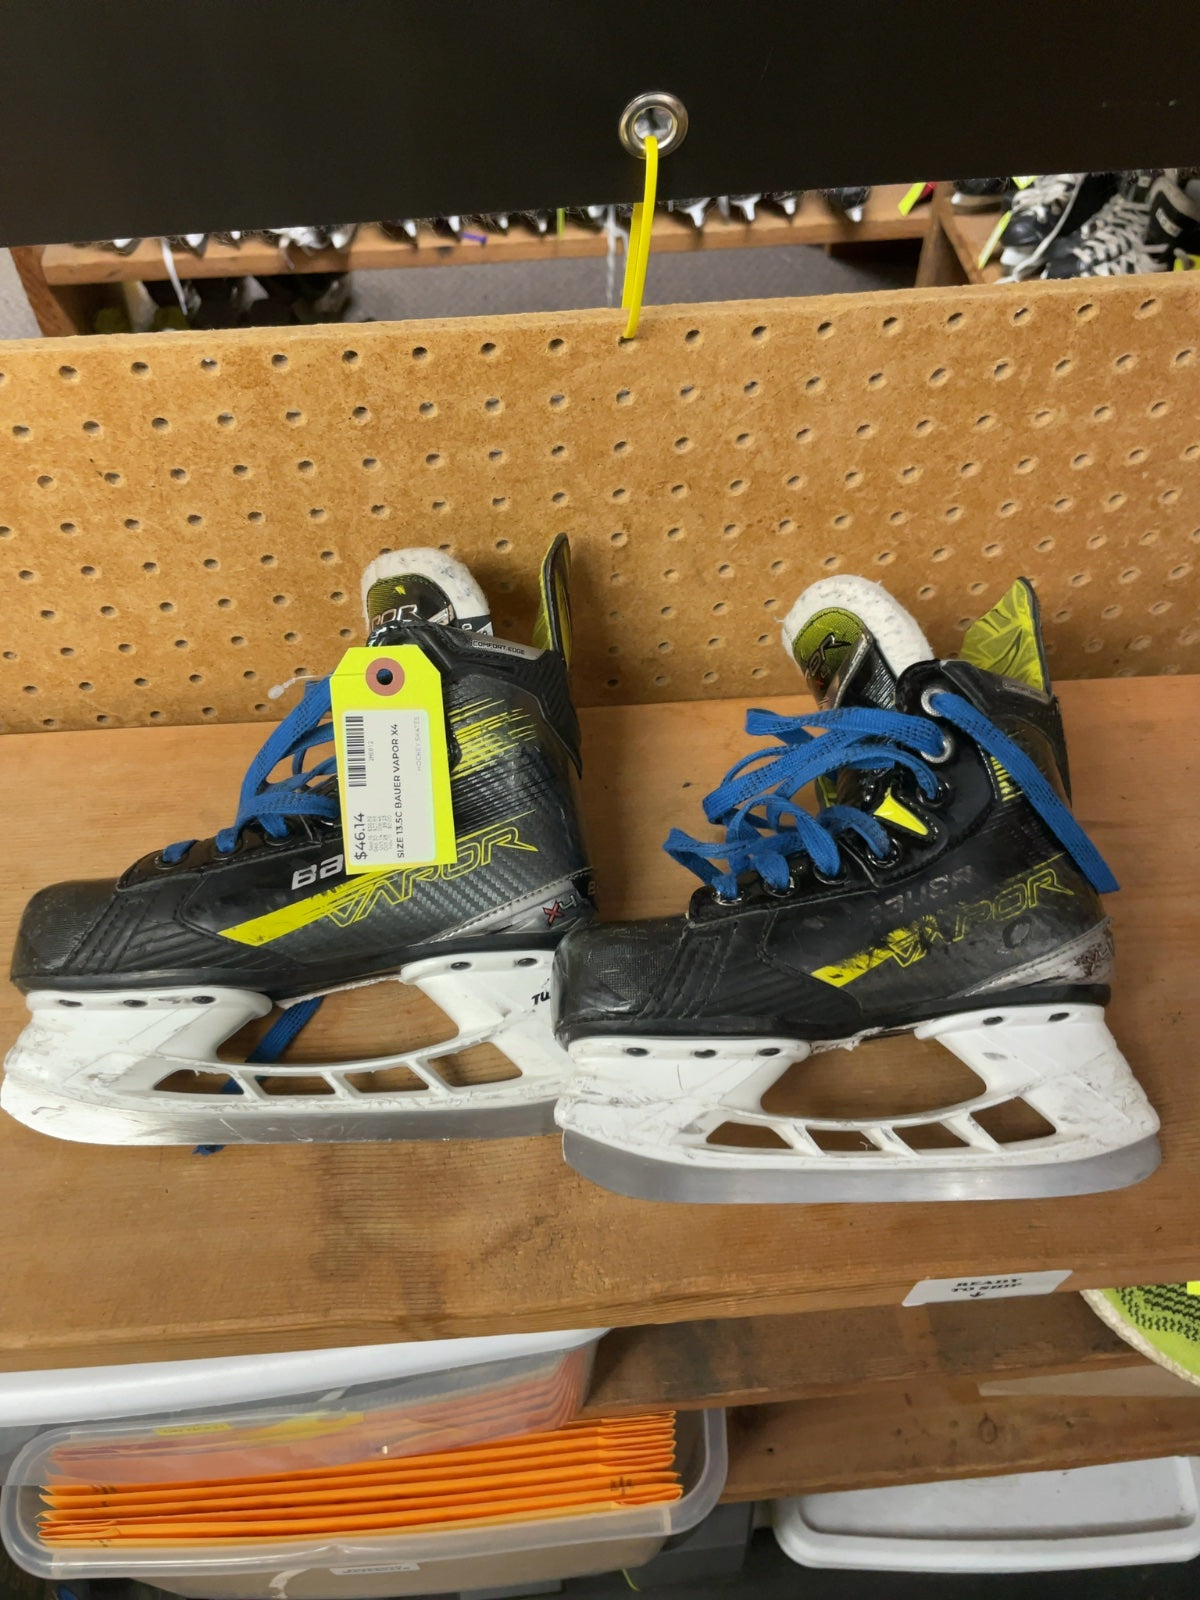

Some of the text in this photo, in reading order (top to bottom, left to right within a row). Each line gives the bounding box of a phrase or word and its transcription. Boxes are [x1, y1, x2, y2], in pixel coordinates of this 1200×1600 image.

[390, 724, 405, 858] SIZE 13.5C BAUER VAPOR X4
[353, 812, 368, 860] $46.14
[531, 991, 551, 1005] TU
